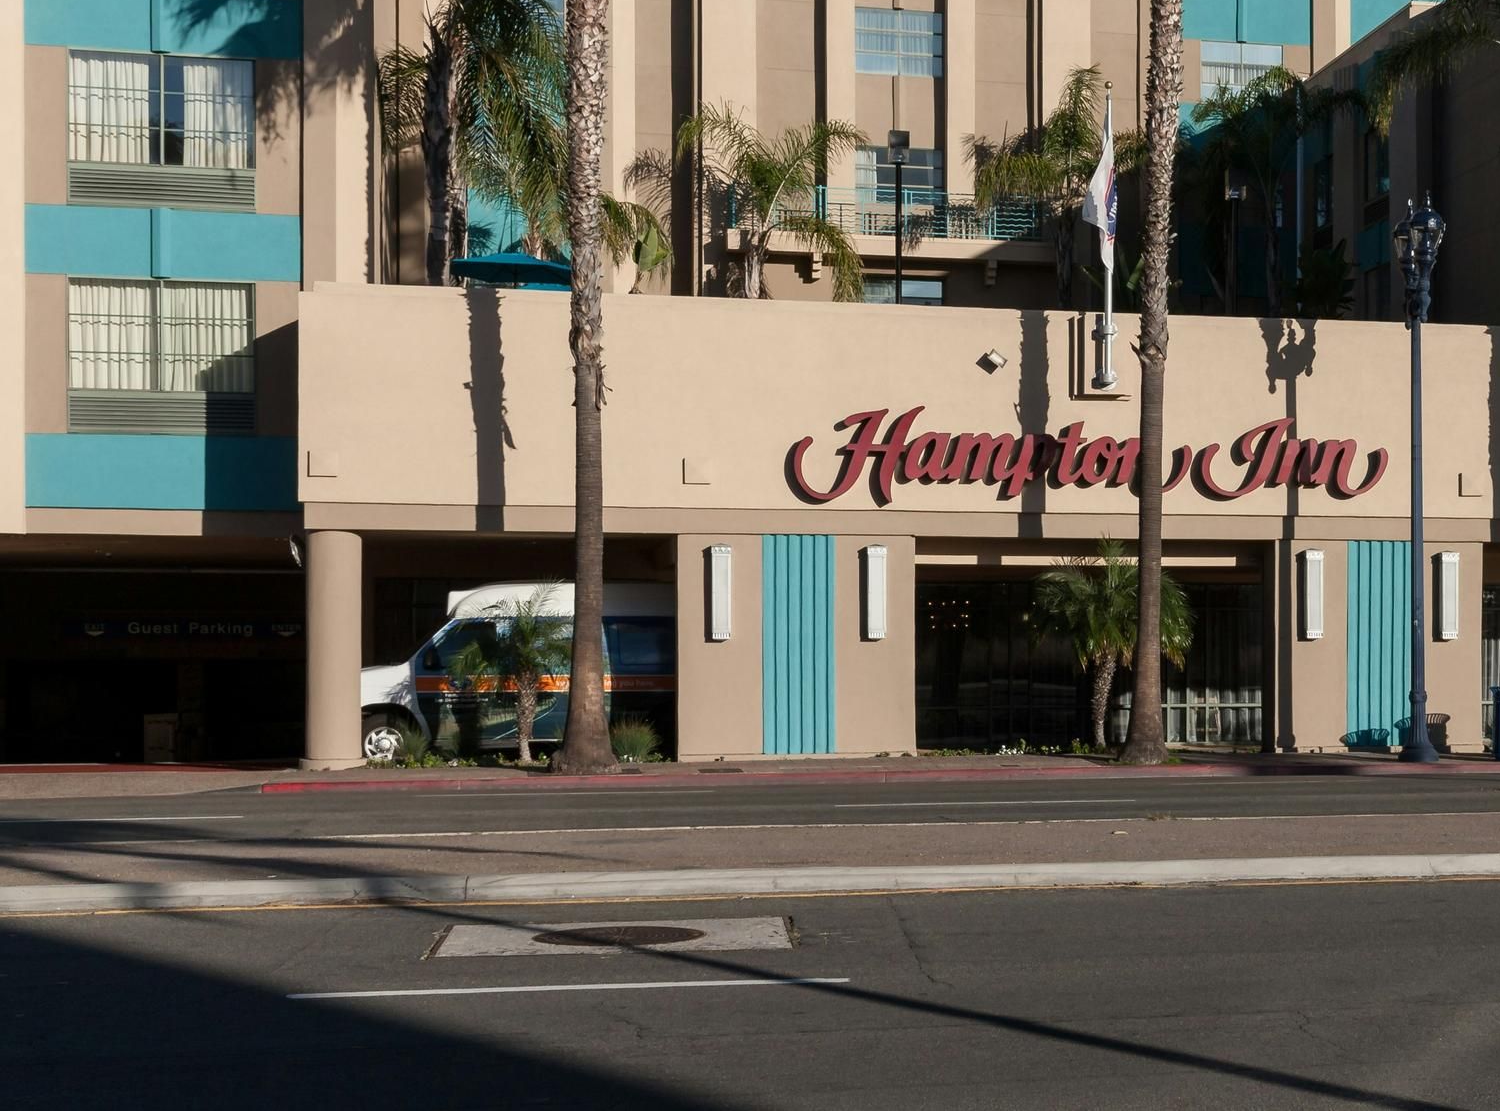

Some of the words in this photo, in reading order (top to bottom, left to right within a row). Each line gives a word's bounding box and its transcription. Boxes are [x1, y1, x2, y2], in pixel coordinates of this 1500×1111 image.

[1199, 417, 1389, 498] Inn
[127, 621, 177, 635] Guest
[189, 621, 254, 637] Parking
